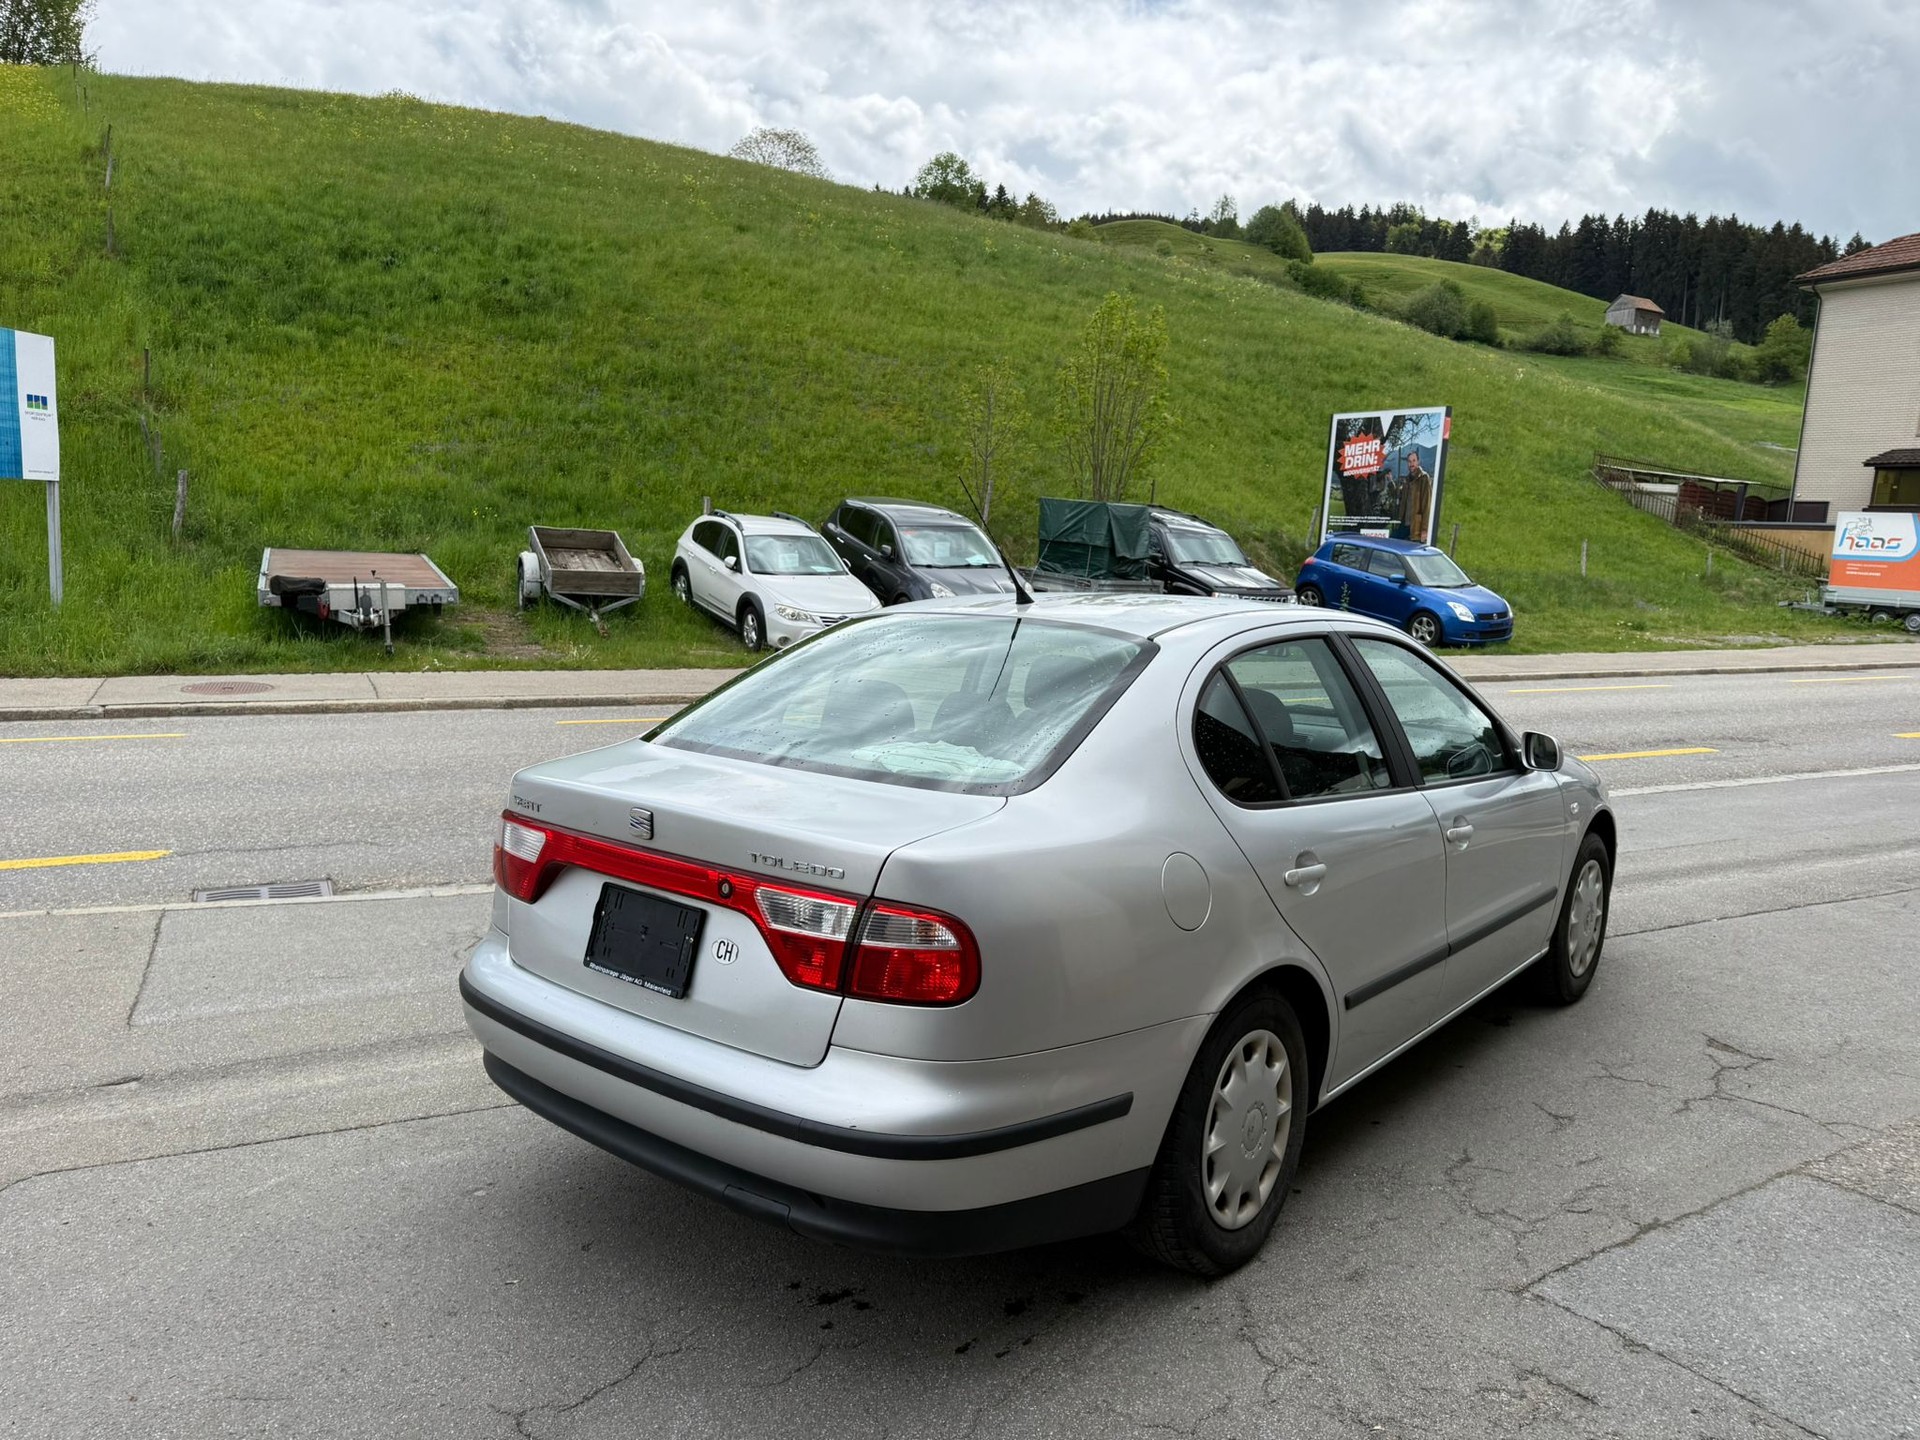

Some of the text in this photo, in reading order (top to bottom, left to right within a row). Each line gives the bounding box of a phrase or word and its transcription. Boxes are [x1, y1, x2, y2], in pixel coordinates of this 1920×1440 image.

[1344, 440, 1381, 457] MEHR
[1344, 453, 1378, 469] DRIN:
[1839, 528, 1903, 550] haas
[746, 850, 846, 880] TOLEDO
[716, 940, 734, 962] CH
